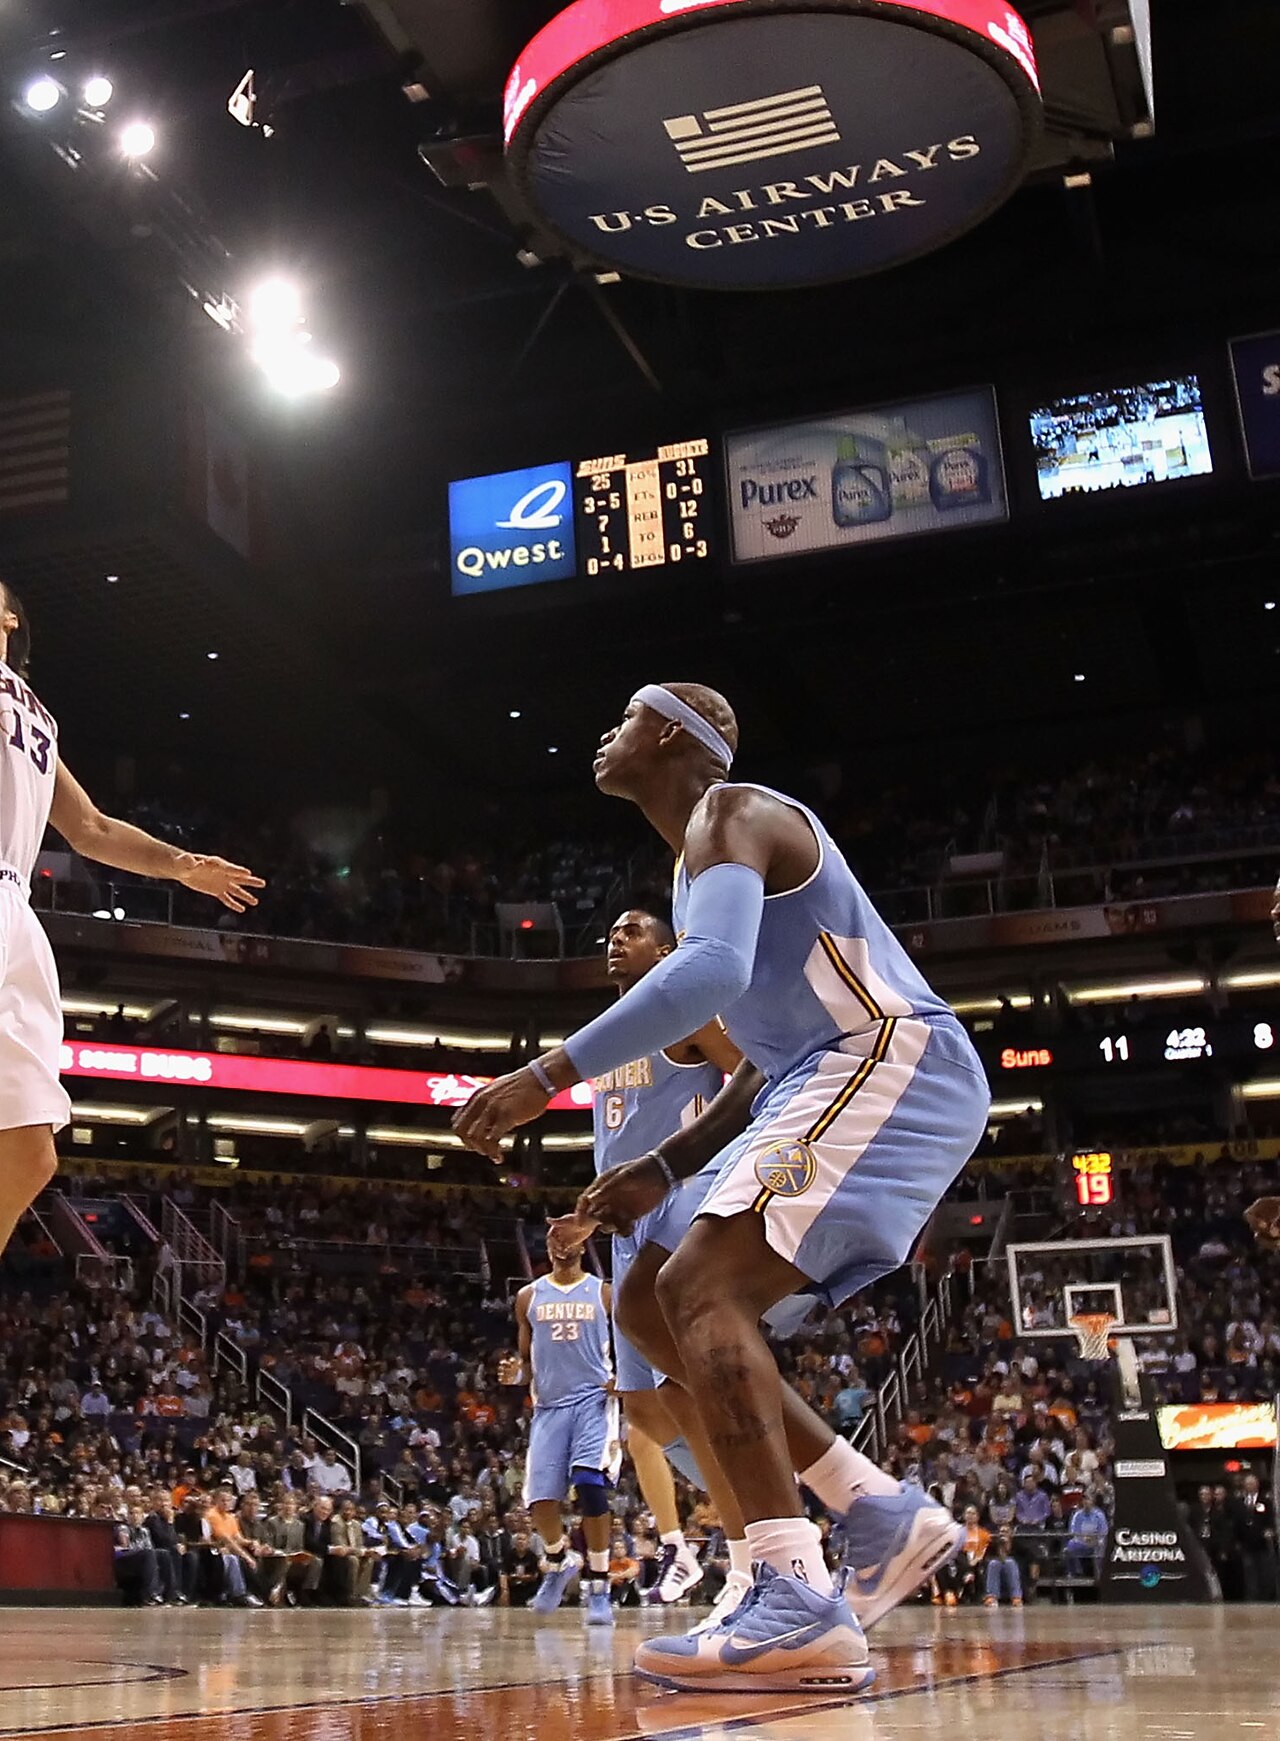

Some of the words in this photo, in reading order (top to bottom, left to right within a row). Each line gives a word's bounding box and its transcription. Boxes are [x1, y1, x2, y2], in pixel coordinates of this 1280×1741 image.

[696, 134, 981, 219] AIRWAYS
[685, 189, 926, 250] CENTER
[591, 473, 611, 492] 25
[675, 458, 696, 477] 31
[740, 474, 818, 508] Purex
[598, 515, 609, 533] 7
[634, 511, 658, 523] REB
[679, 500, 698, 519] 12
[601, 536, 611, 553] 1
[639, 533, 656, 543] TO
[683, 522, 695, 540] 6
[457, 540, 562, 578] Qwest
[8, 706, 51, 775] 13
[1001, 1048, 1052, 1069] Suns
[1099, 1035, 1129, 1062] 11
[1253, 1022, 1274, 1049] 8
[605, 1096, 624, 1131] 6
[1076, 1173, 1113, 1205] 19
[536, 1304, 596, 1322] DENVER
[551, 1322, 580, 1342] 23
[1115, 1527, 1178, 1547] CASINO
[1111, 1546, 1186, 1563] ARIZONA
